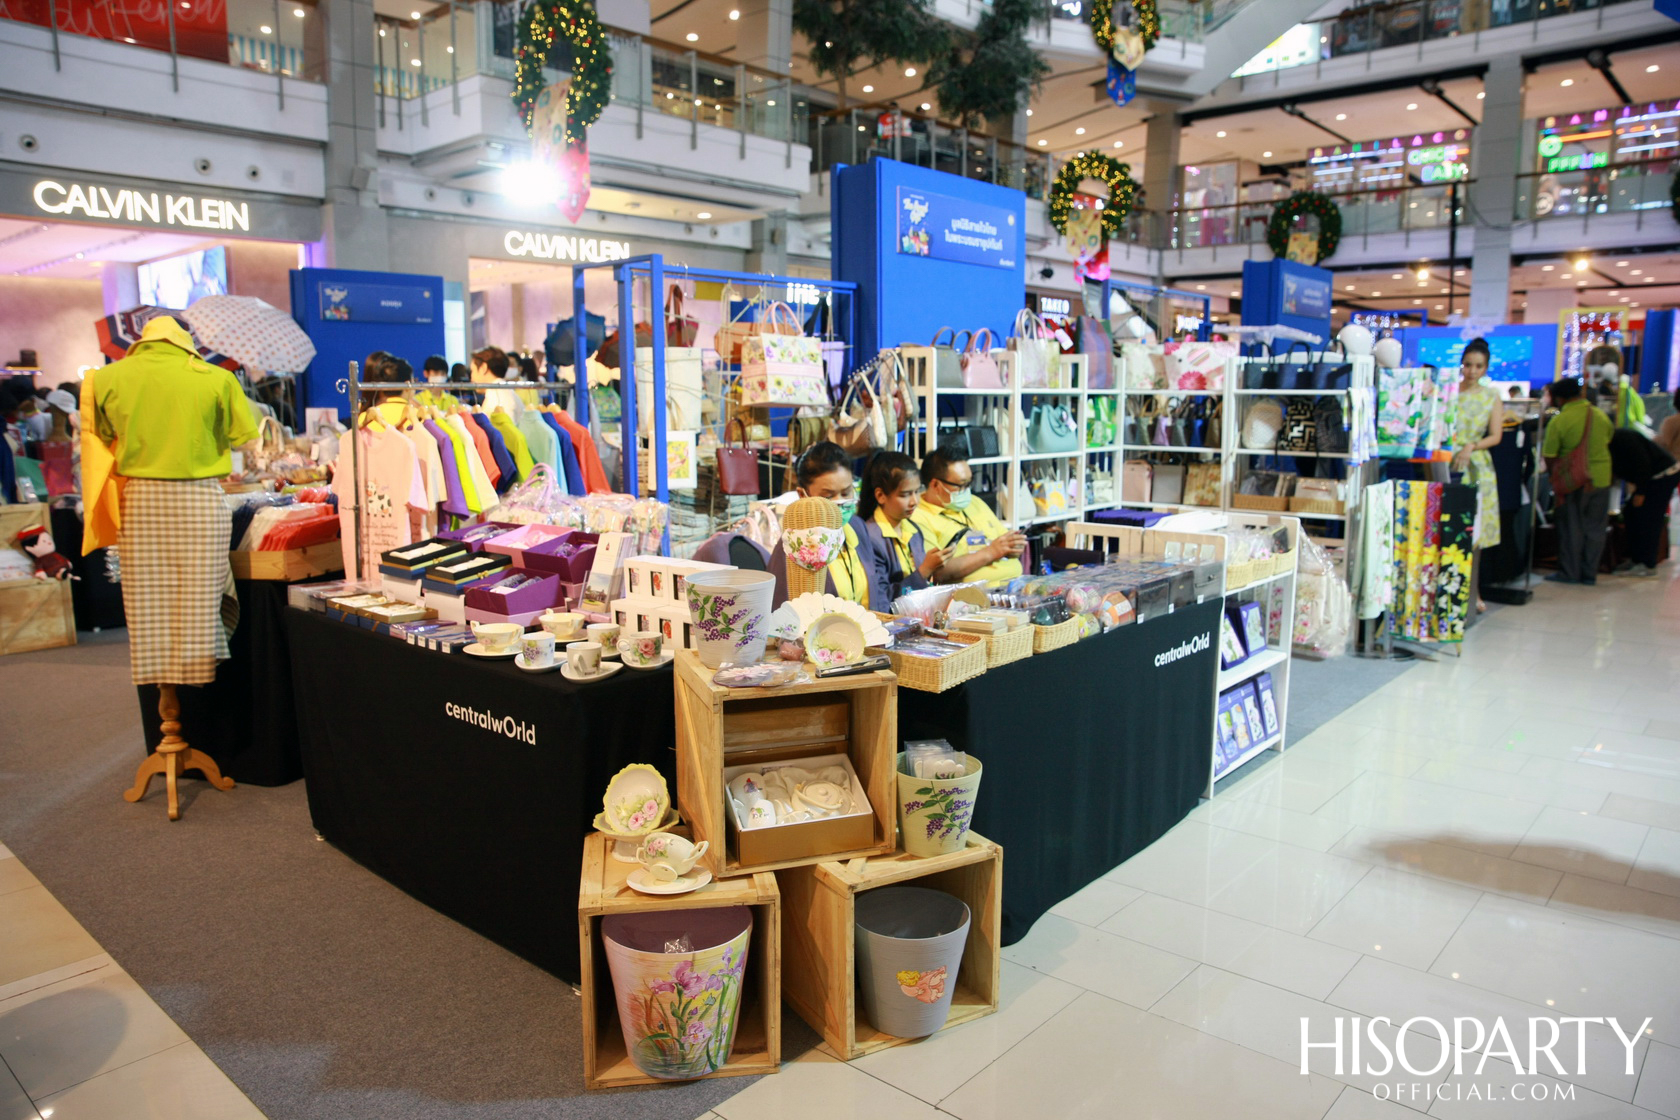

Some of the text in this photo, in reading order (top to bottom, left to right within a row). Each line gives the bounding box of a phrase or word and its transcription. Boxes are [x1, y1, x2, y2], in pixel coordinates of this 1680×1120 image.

[33, 180, 250, 231] CALVIN KLEIN
[504, 230, 630, 263] CALVIN KLEIN
[1154, 631, 1210, 667] centralwOrld
[445, 701, 536, 746] centralwOrld
